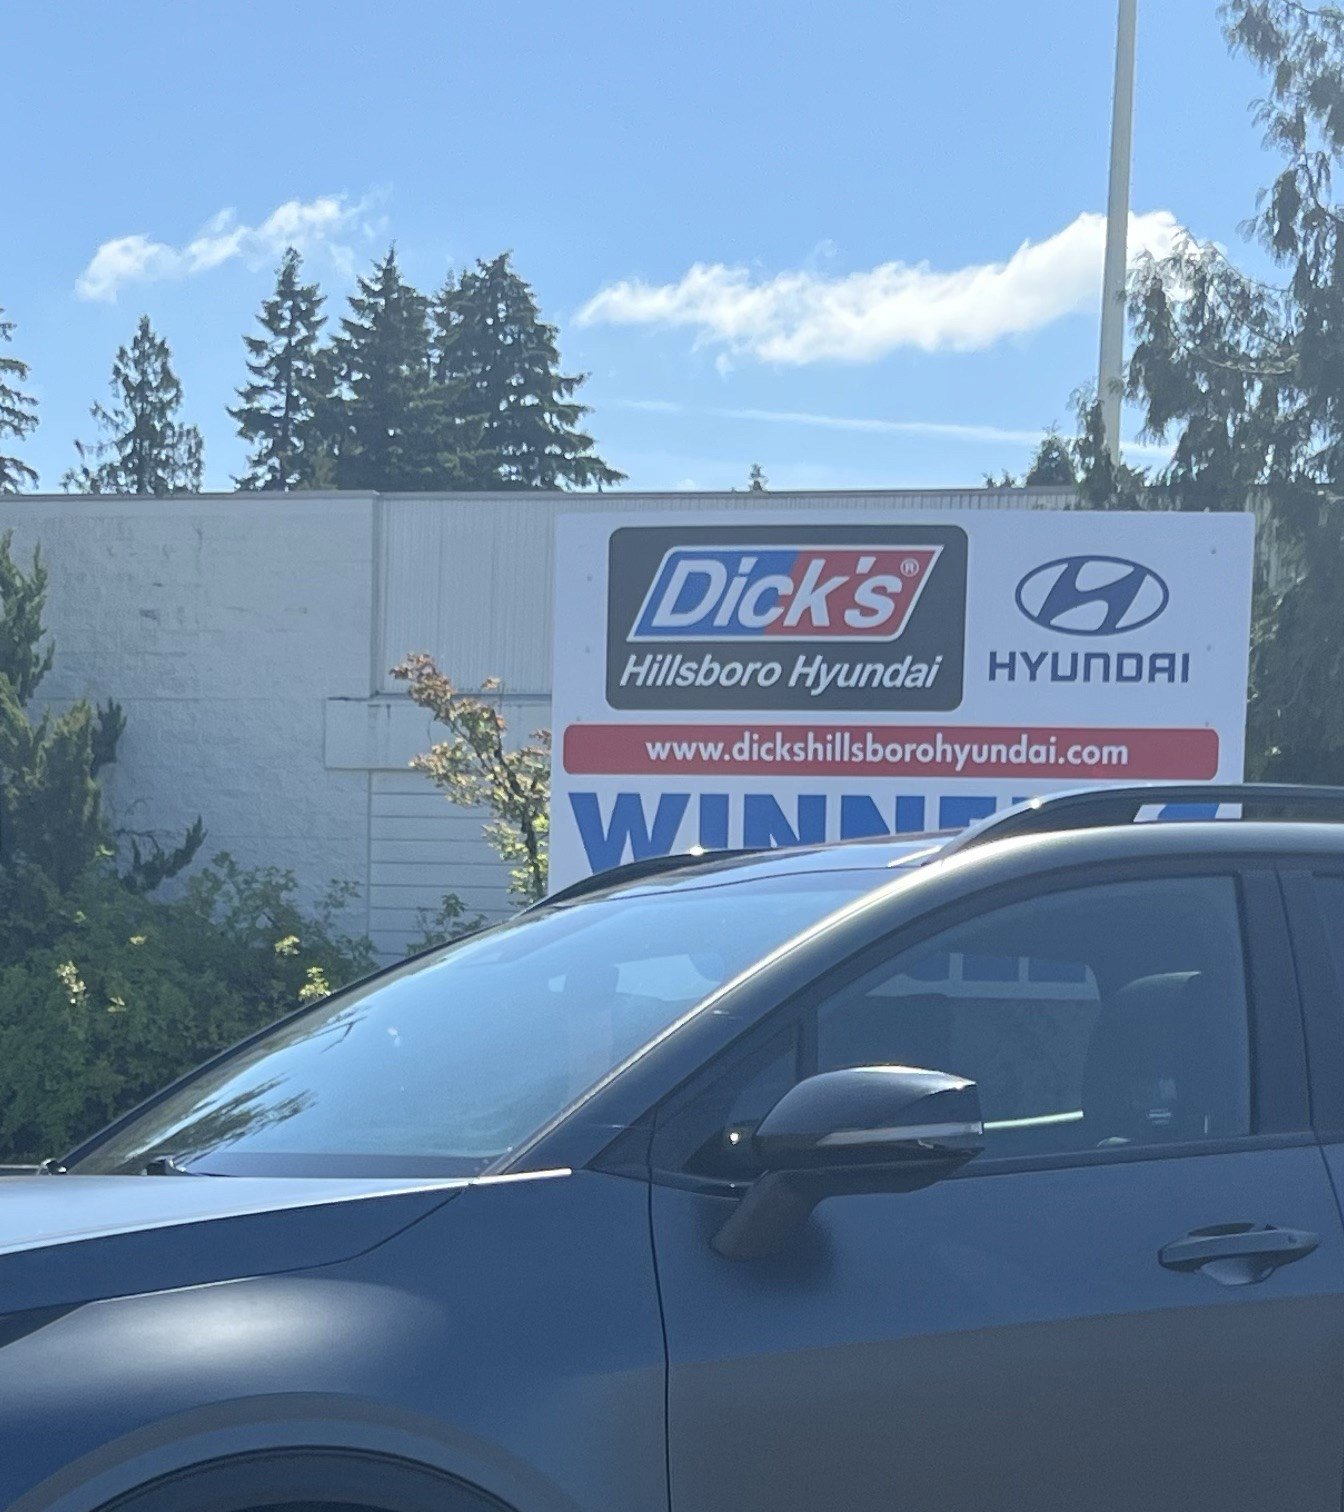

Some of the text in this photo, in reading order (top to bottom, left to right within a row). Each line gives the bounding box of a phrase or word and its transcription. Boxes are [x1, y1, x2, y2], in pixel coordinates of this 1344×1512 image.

[650, 555, 903, 629] Dick's
[619, 655, 943, 696] Hillsboro Hyundai
[988, 651, 1190, 683] HYUNDAI
[645, 731, 1129, 771] www.dickshillsborohyundai.com
